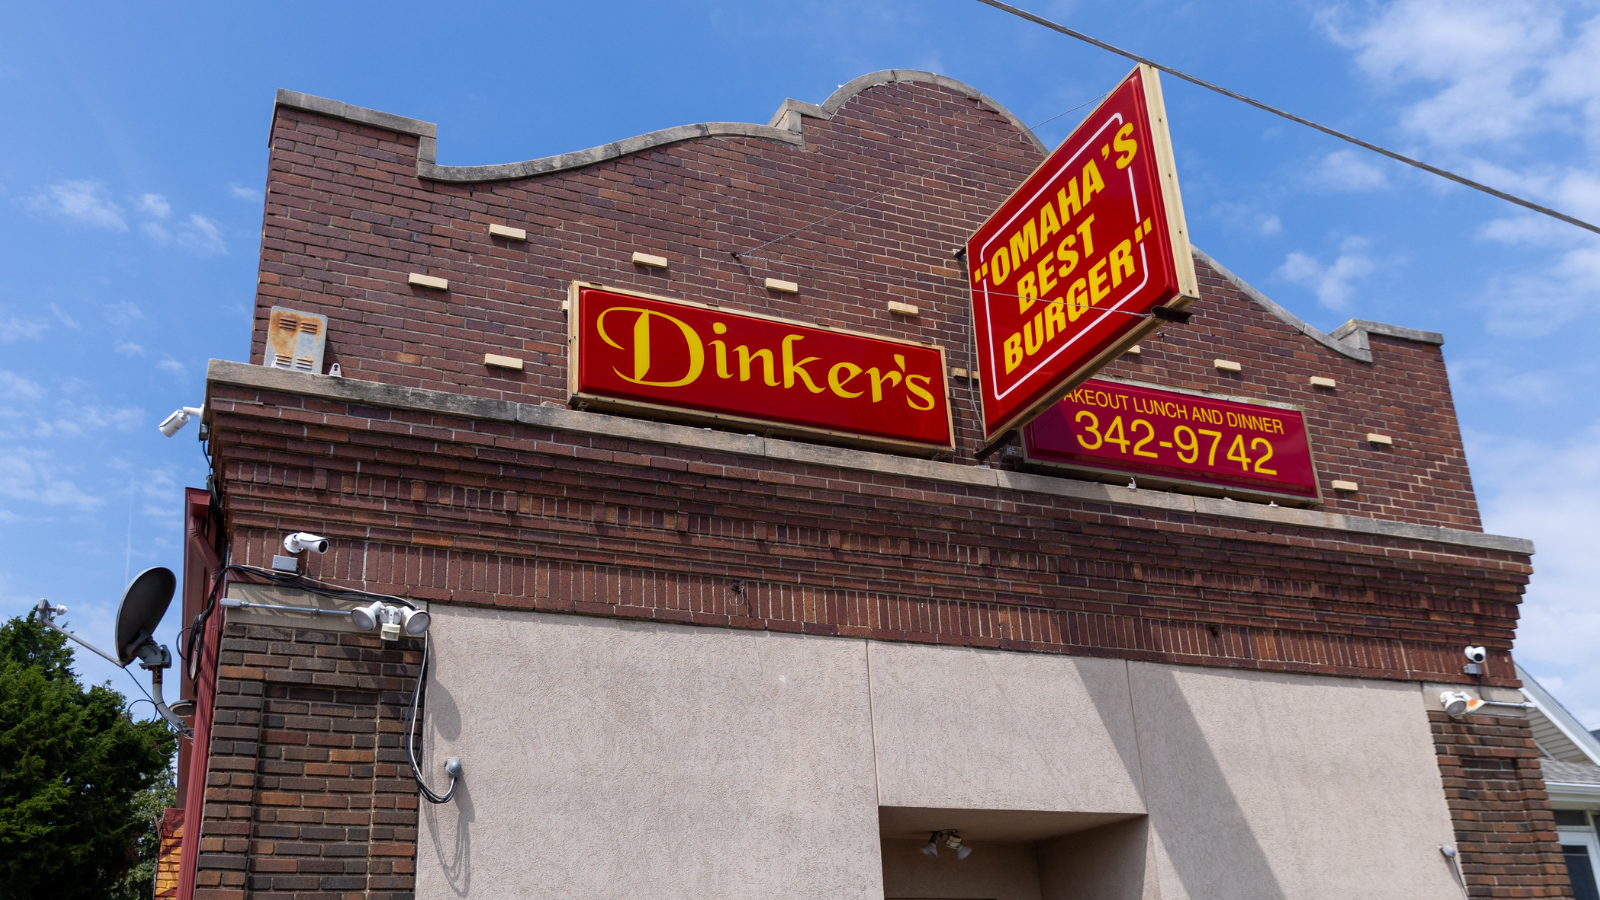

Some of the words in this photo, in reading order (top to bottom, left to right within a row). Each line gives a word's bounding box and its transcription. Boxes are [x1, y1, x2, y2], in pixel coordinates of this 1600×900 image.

[974, 122, 1138, 286] "OMAHA'S
[1003, 217, 1152, 375] BURGER"
[1016, 213, 1095, 315] BEST
[596, 306, 935, 411] Dinker's
[1063, 388, 1128, 410] AKEOUT
[1133, 397, 1188, 420] LUNCH
[1192, 407, 1223, 425] AND
[1226, 411, 1284, 435] DINNER
[1075, 410, 1277, 476] 342-9742
